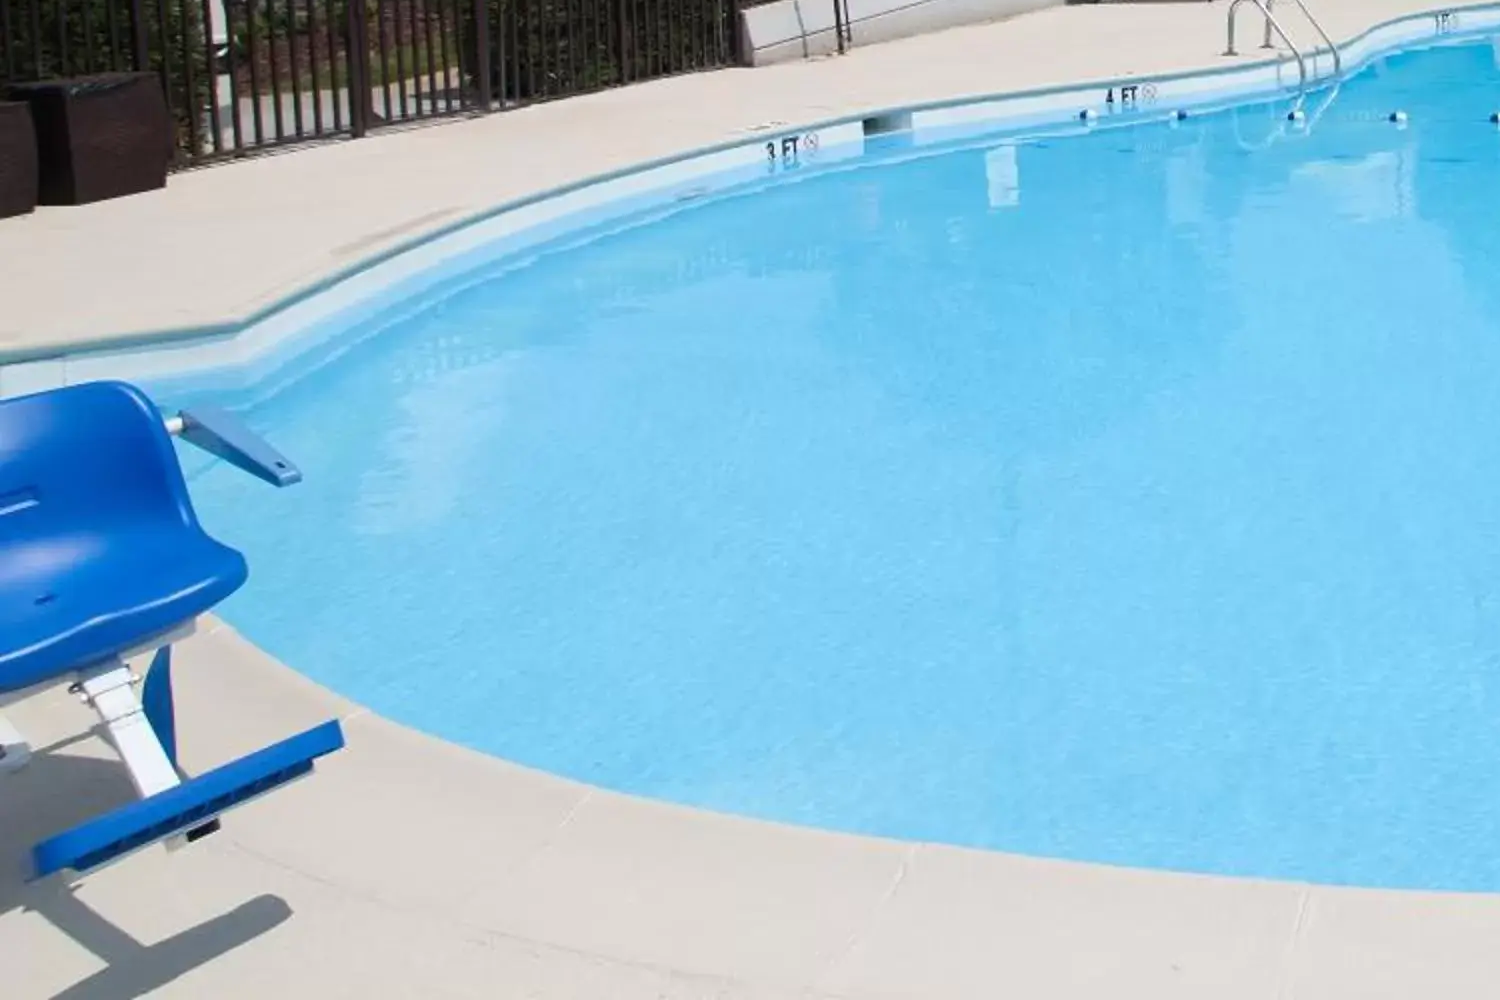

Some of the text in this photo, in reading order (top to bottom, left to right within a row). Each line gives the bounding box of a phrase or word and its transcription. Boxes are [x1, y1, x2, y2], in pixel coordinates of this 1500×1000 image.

[1121, 85, 1139, 103] FT
[765, 135, 799, 161] 3 FT
